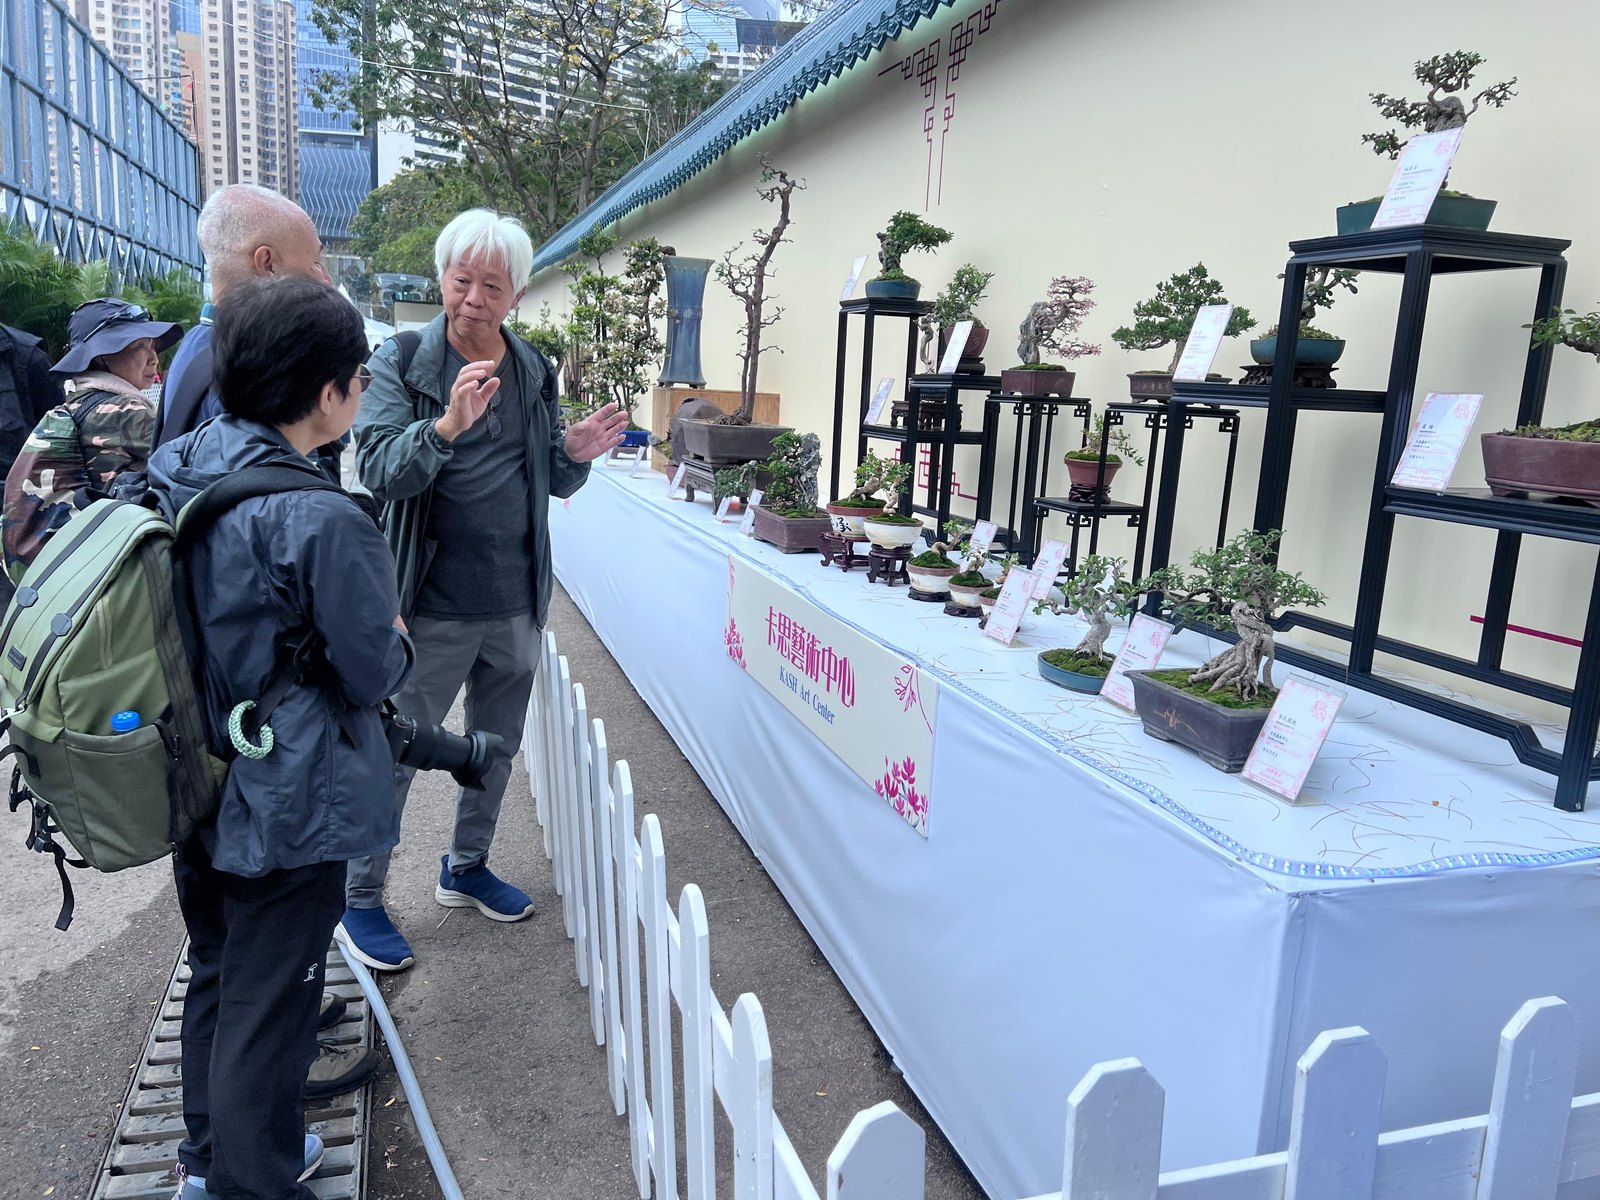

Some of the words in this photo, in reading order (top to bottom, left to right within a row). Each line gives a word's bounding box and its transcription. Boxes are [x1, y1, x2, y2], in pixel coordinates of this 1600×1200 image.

[765, 606, 855, 708] 卡思藝術中心
[779, 665, 798, 694] KASH
[800, 683, 811, 705] Art
[812, 694, 835, 725] Center
